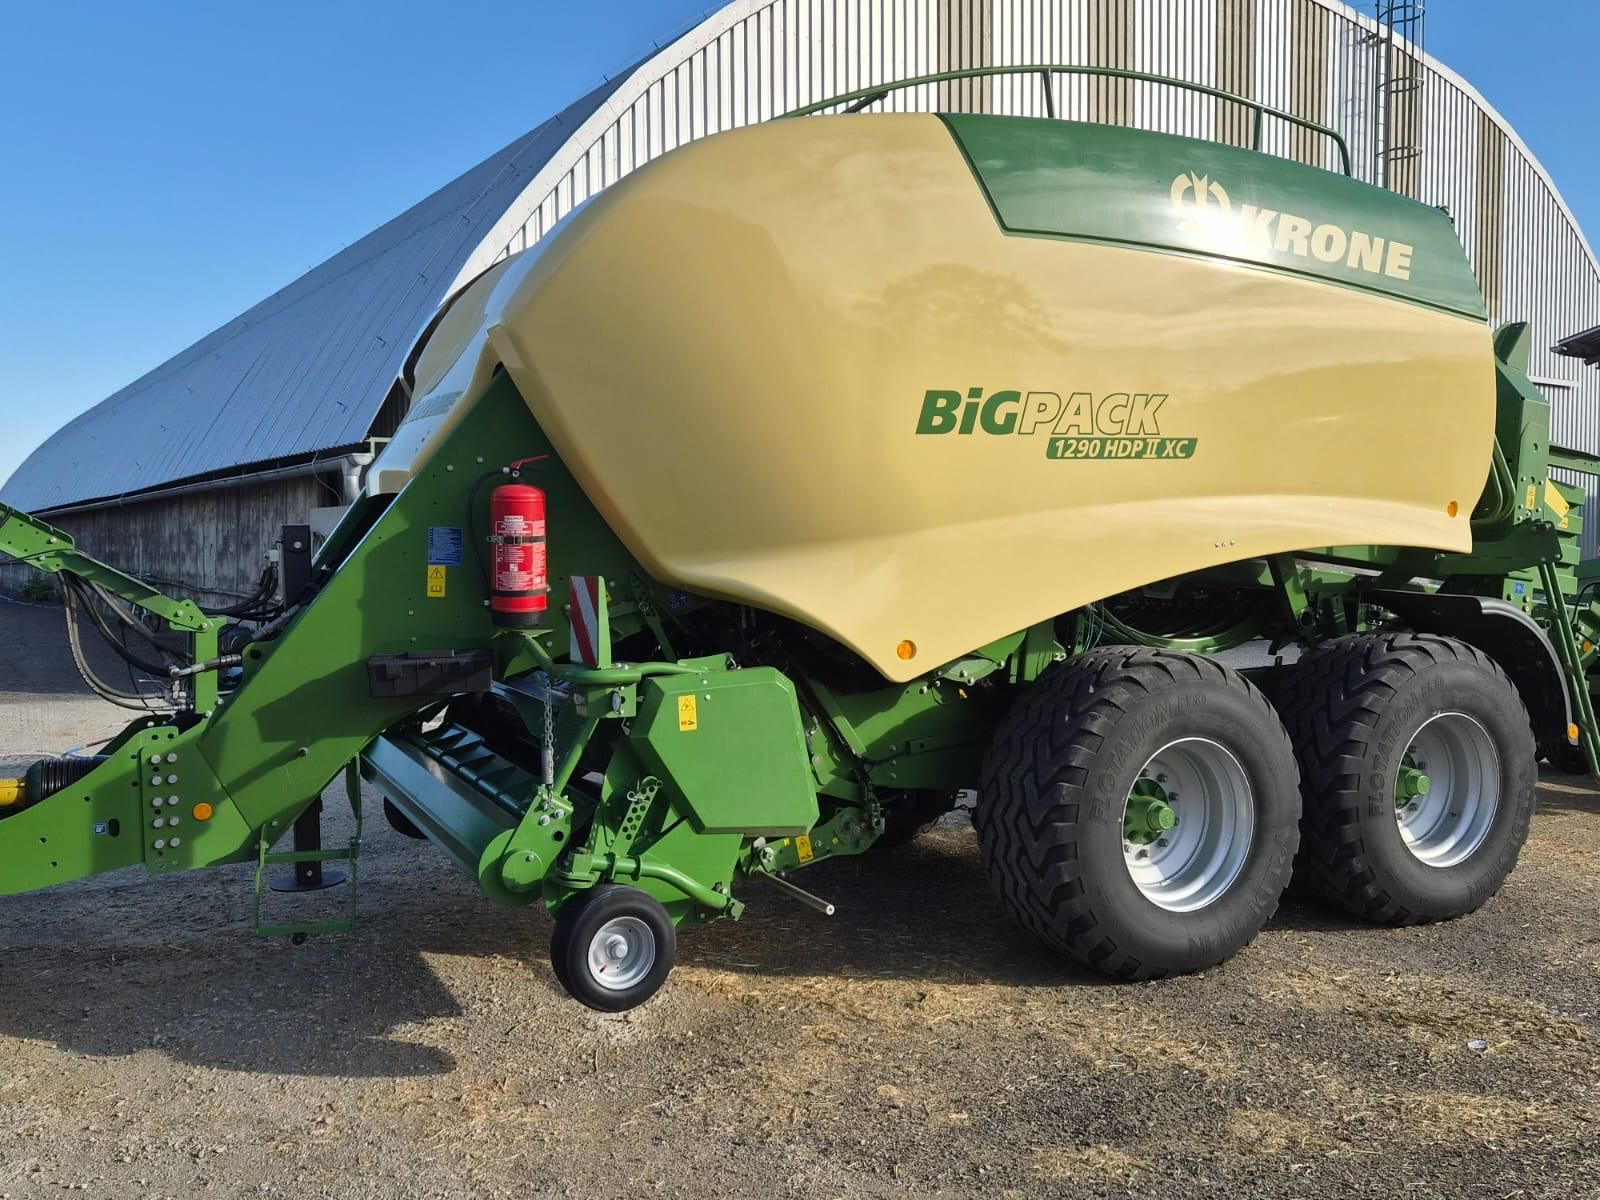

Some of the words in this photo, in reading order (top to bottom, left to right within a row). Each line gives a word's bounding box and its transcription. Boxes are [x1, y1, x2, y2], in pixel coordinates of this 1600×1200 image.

[1237, 204, 1414, 281] KRONE
[1055, 439, 1101, 458] 1290
[1163, 440, 1187, 457] XC
